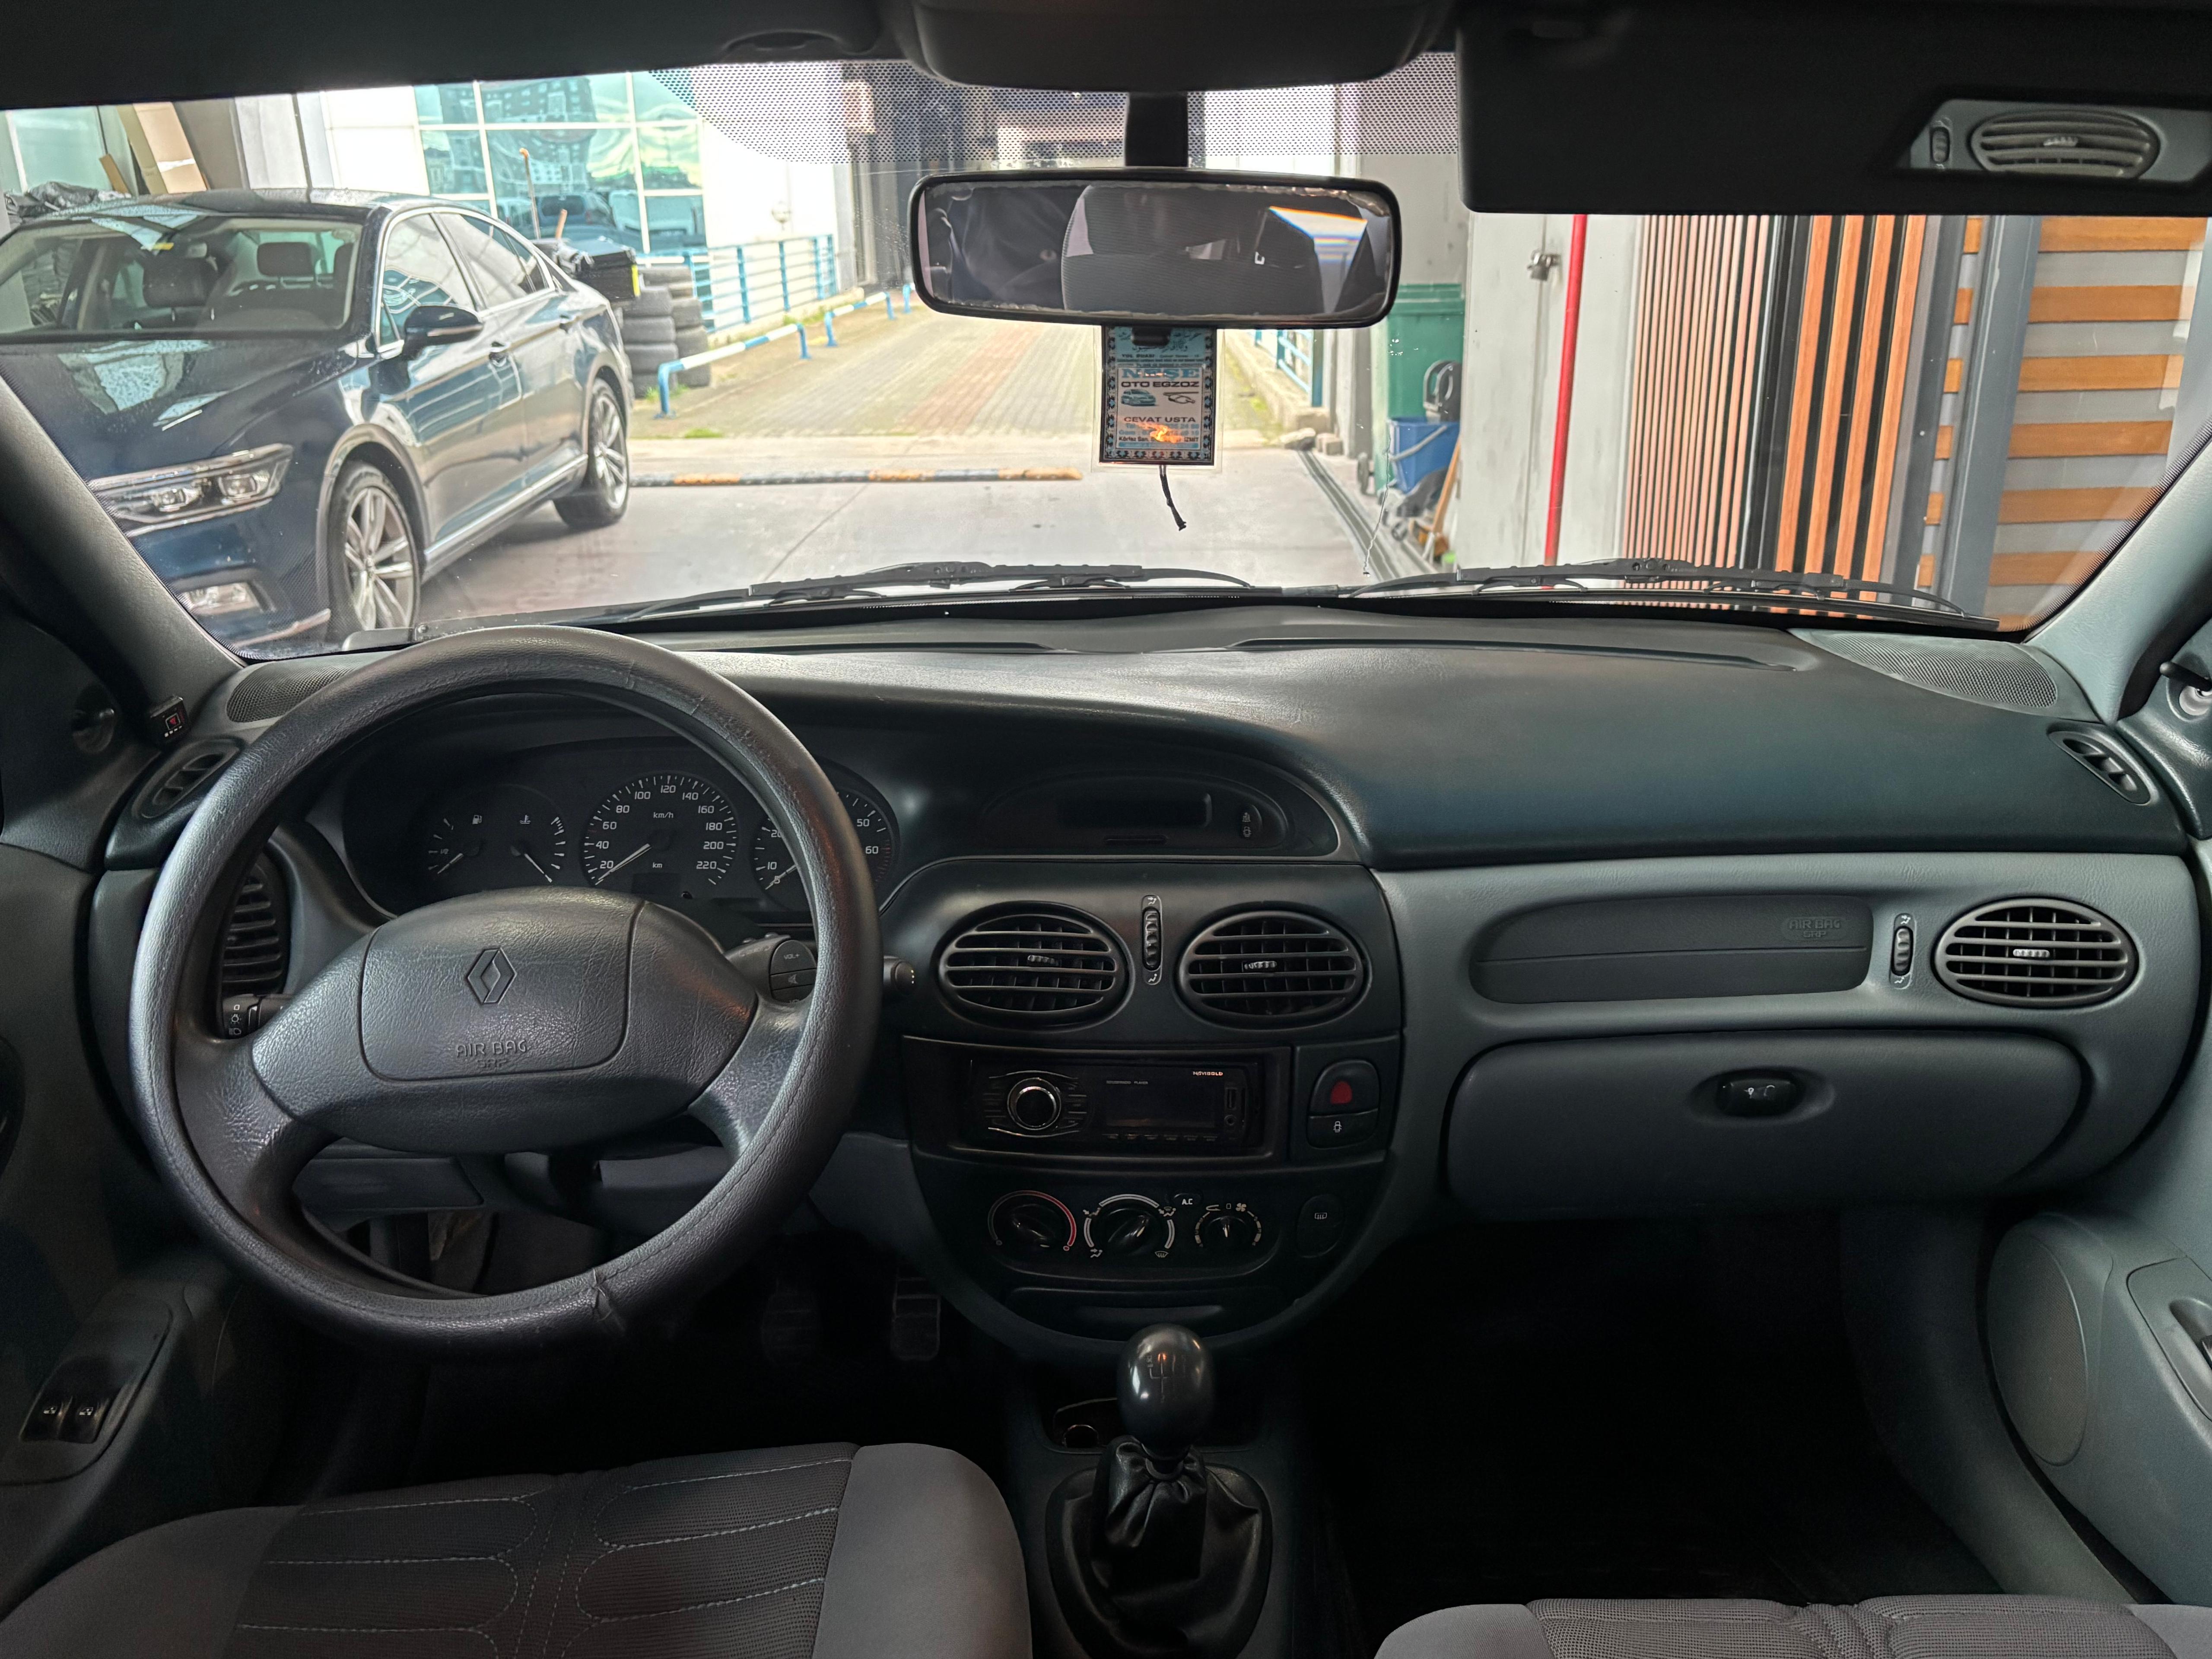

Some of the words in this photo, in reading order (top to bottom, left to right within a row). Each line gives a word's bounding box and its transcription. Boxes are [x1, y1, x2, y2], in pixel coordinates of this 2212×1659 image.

[660, 785, 676, 793] 120
[616, 805, 629, 813] 80
[698, 805, 714, 814] 160
[602, 821, 617, 830] 60
[856, 819, 870, 827] 50
[595, 841, 609, 849] 40
[865, 845, 879, 854] 60
[600, 861, 614, 869] 20
[696, 861, 717, 869] 220
[767, 861, 777, 870] 10
[1789, 919, 1812, 929] AIR
[1814, 918, 1840, 928] BAG
[456, 1042, 486, 1058] AIR
[492, 1039, 528, 1055] BAG
